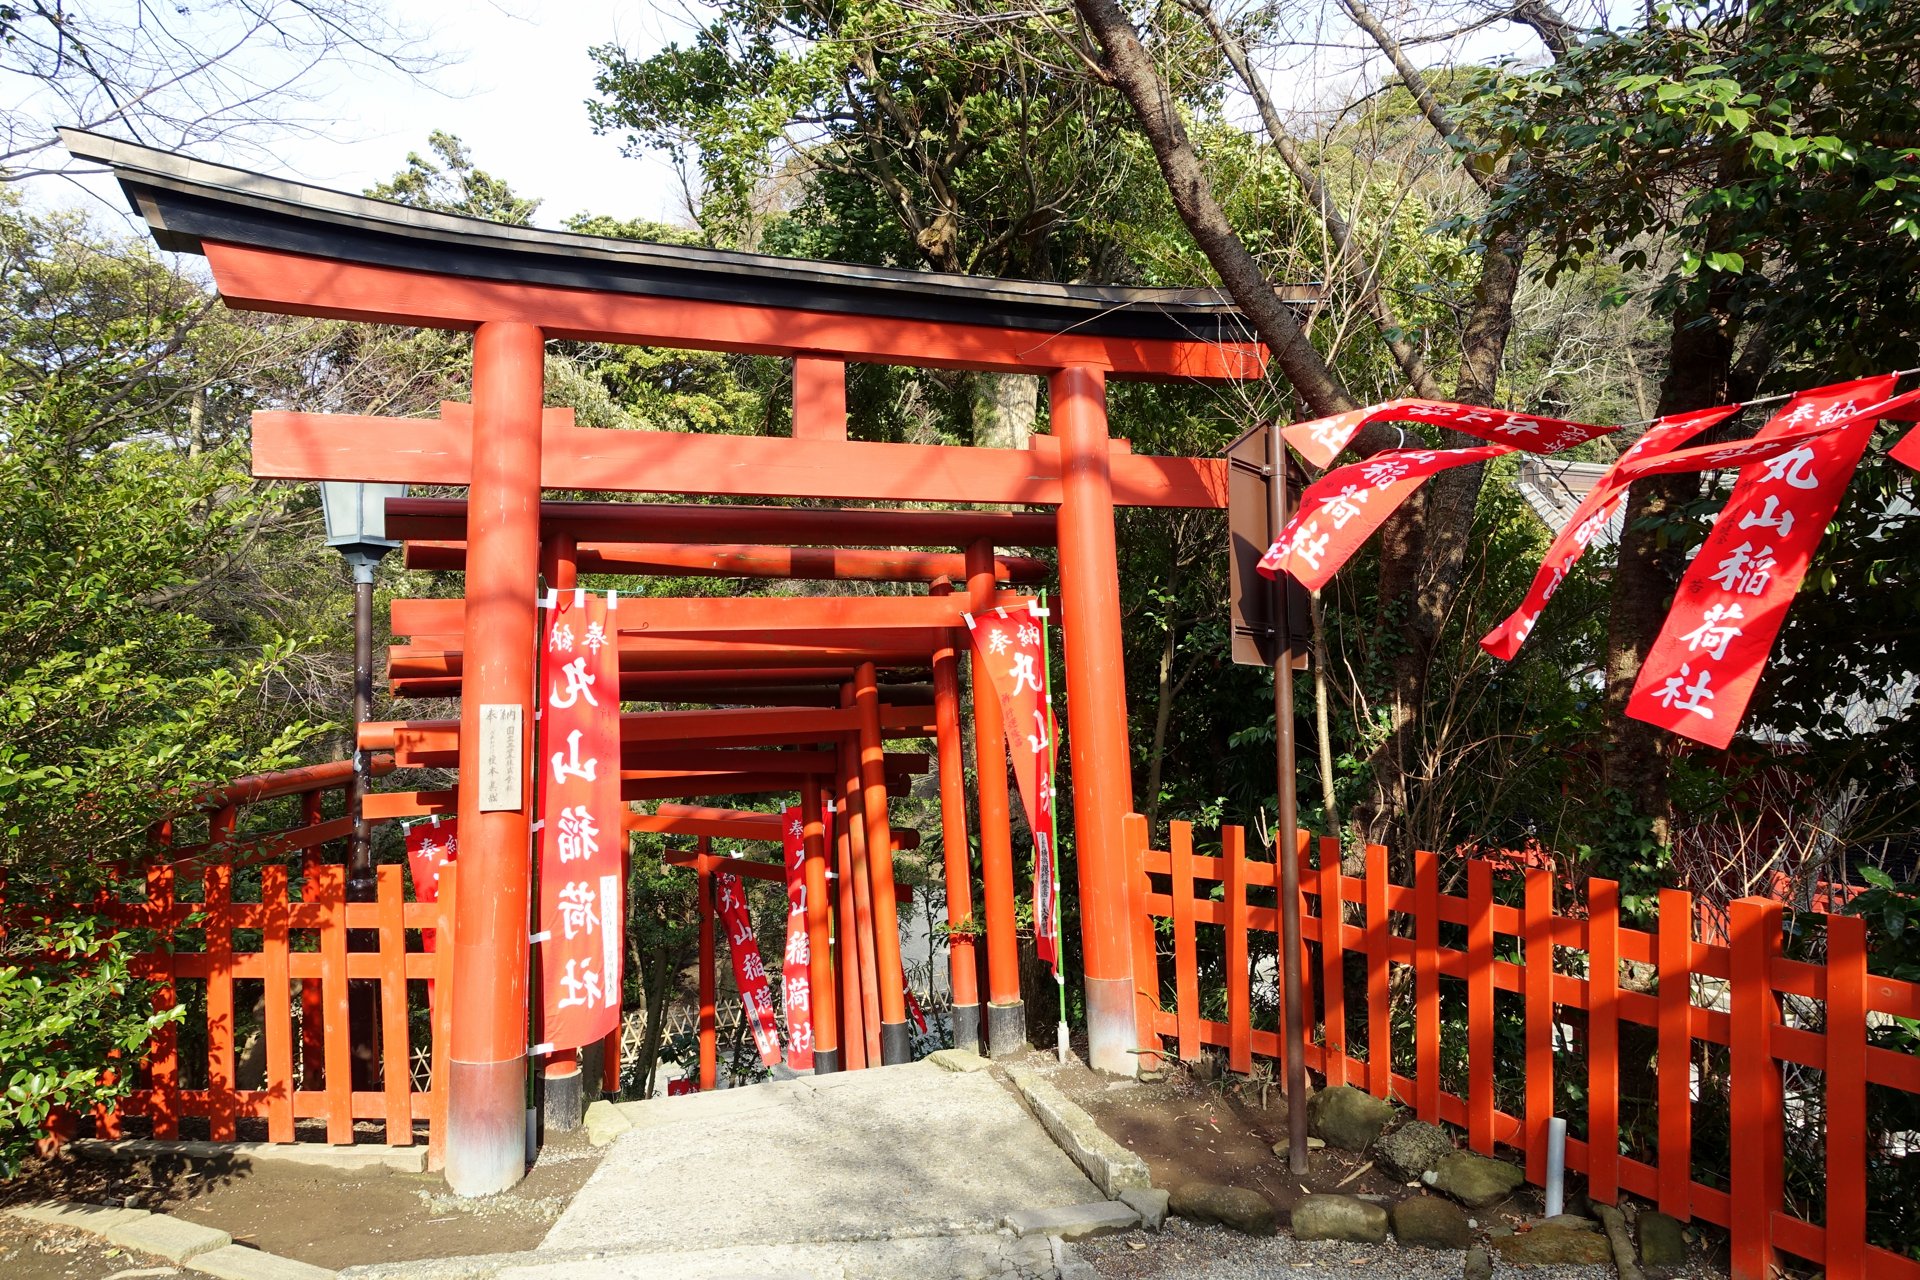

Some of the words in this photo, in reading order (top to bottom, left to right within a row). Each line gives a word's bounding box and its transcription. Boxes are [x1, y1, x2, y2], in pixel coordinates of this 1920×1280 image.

[1780, 401, 1857, 428] 奉納
[1291, 449, 1466, 570] 山稲荷社
[1651, 447, 1819, 720] 丸山稲荷社
[987, 621, 1041, 657] 奉納
